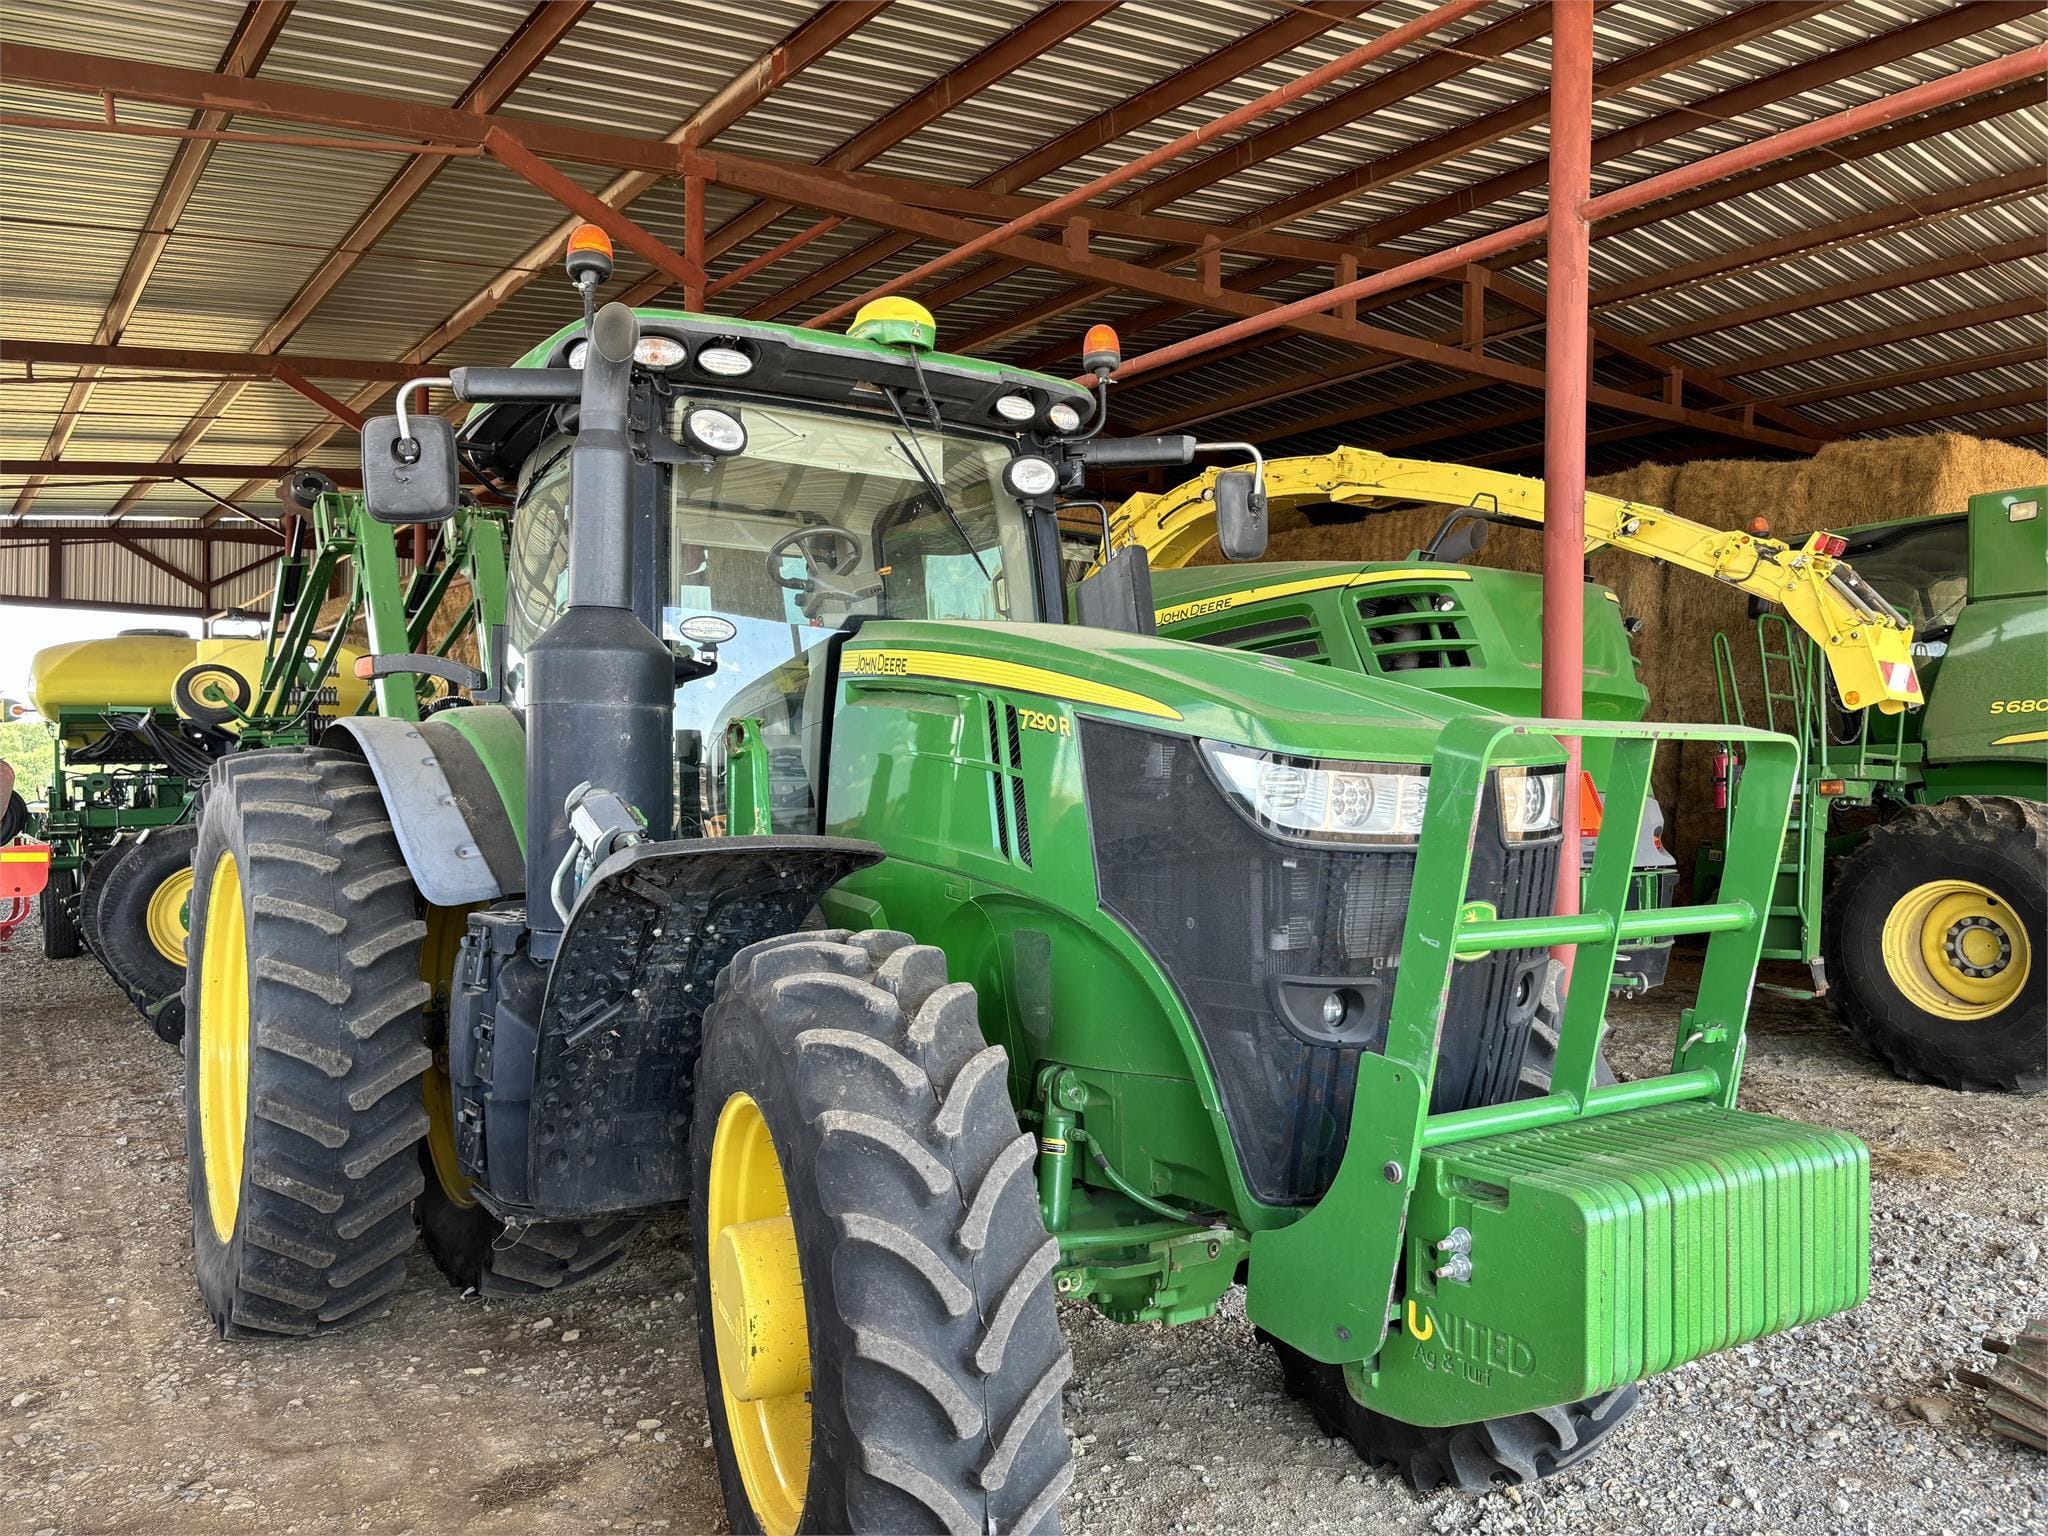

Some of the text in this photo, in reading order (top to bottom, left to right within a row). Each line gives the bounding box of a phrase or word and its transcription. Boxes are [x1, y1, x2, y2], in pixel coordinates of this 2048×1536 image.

[1157, 597, 1232, 624] JOHN DEERE
[855, 653, 907, 673] JOHN DEERE
[1408, 1300, 1536, 1377] UNITED
[1413, 1342, 1493, 1388] Ag & Turf
